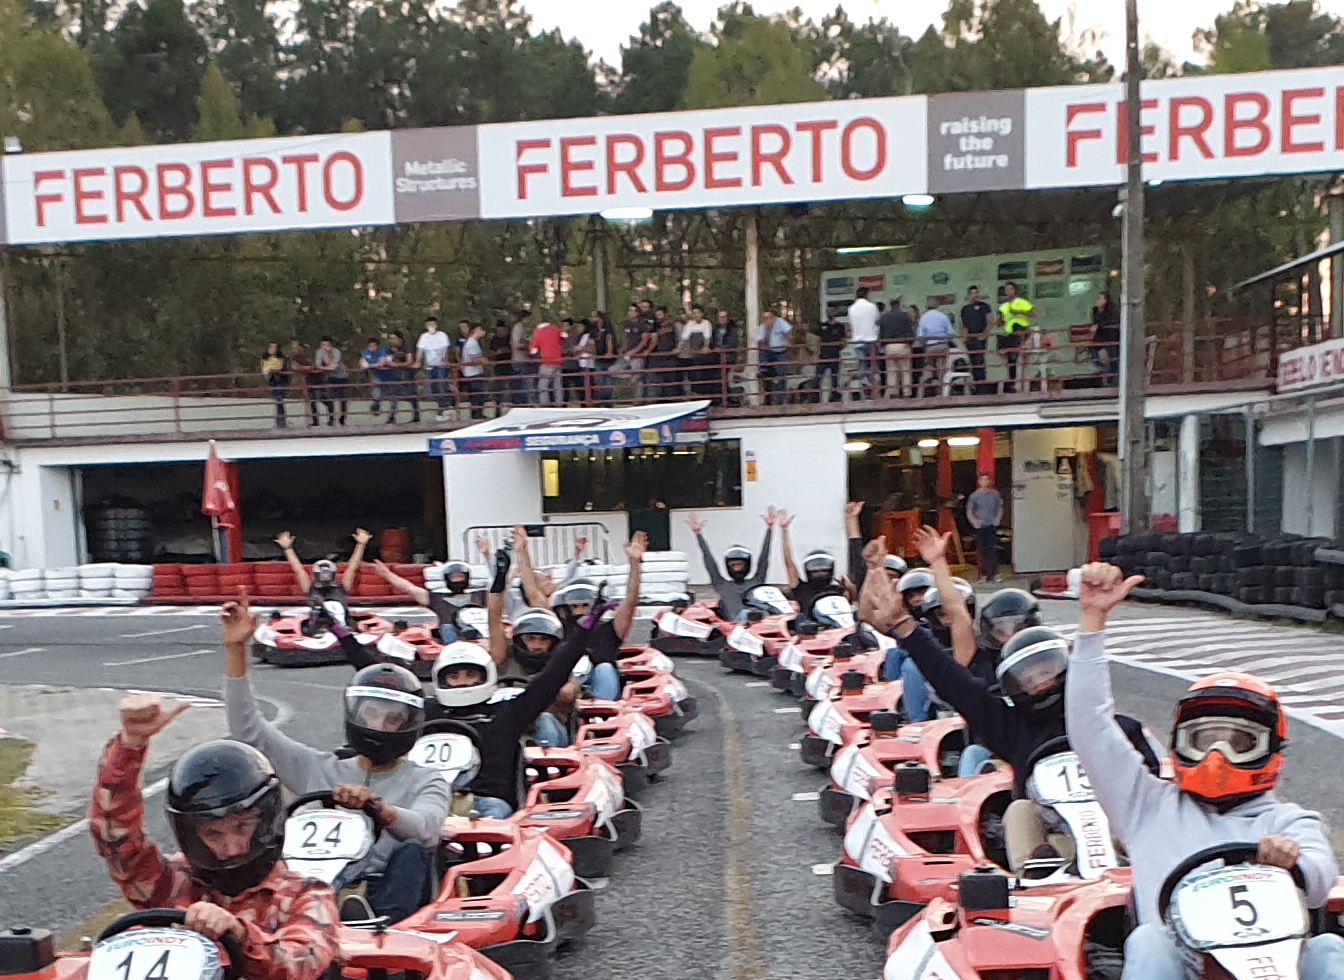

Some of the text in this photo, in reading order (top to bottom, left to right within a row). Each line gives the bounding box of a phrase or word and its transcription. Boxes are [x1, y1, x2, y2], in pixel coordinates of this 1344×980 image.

[939, 115, 1013, 137] raising
[959, 135, 995, 152] the
[404, 158, 469, 175] Metallic
[516, 116, 887, 200] FERBERTO
[942, 153, 1009, 171] future
[33, 150, 364, 227] FERBERTO
[395, 176, 478, 193] Structures
[423, 742, 453, 764] 20
[301, 821, 343, 849] 24
[1228, 884, 1258, 927] 5
